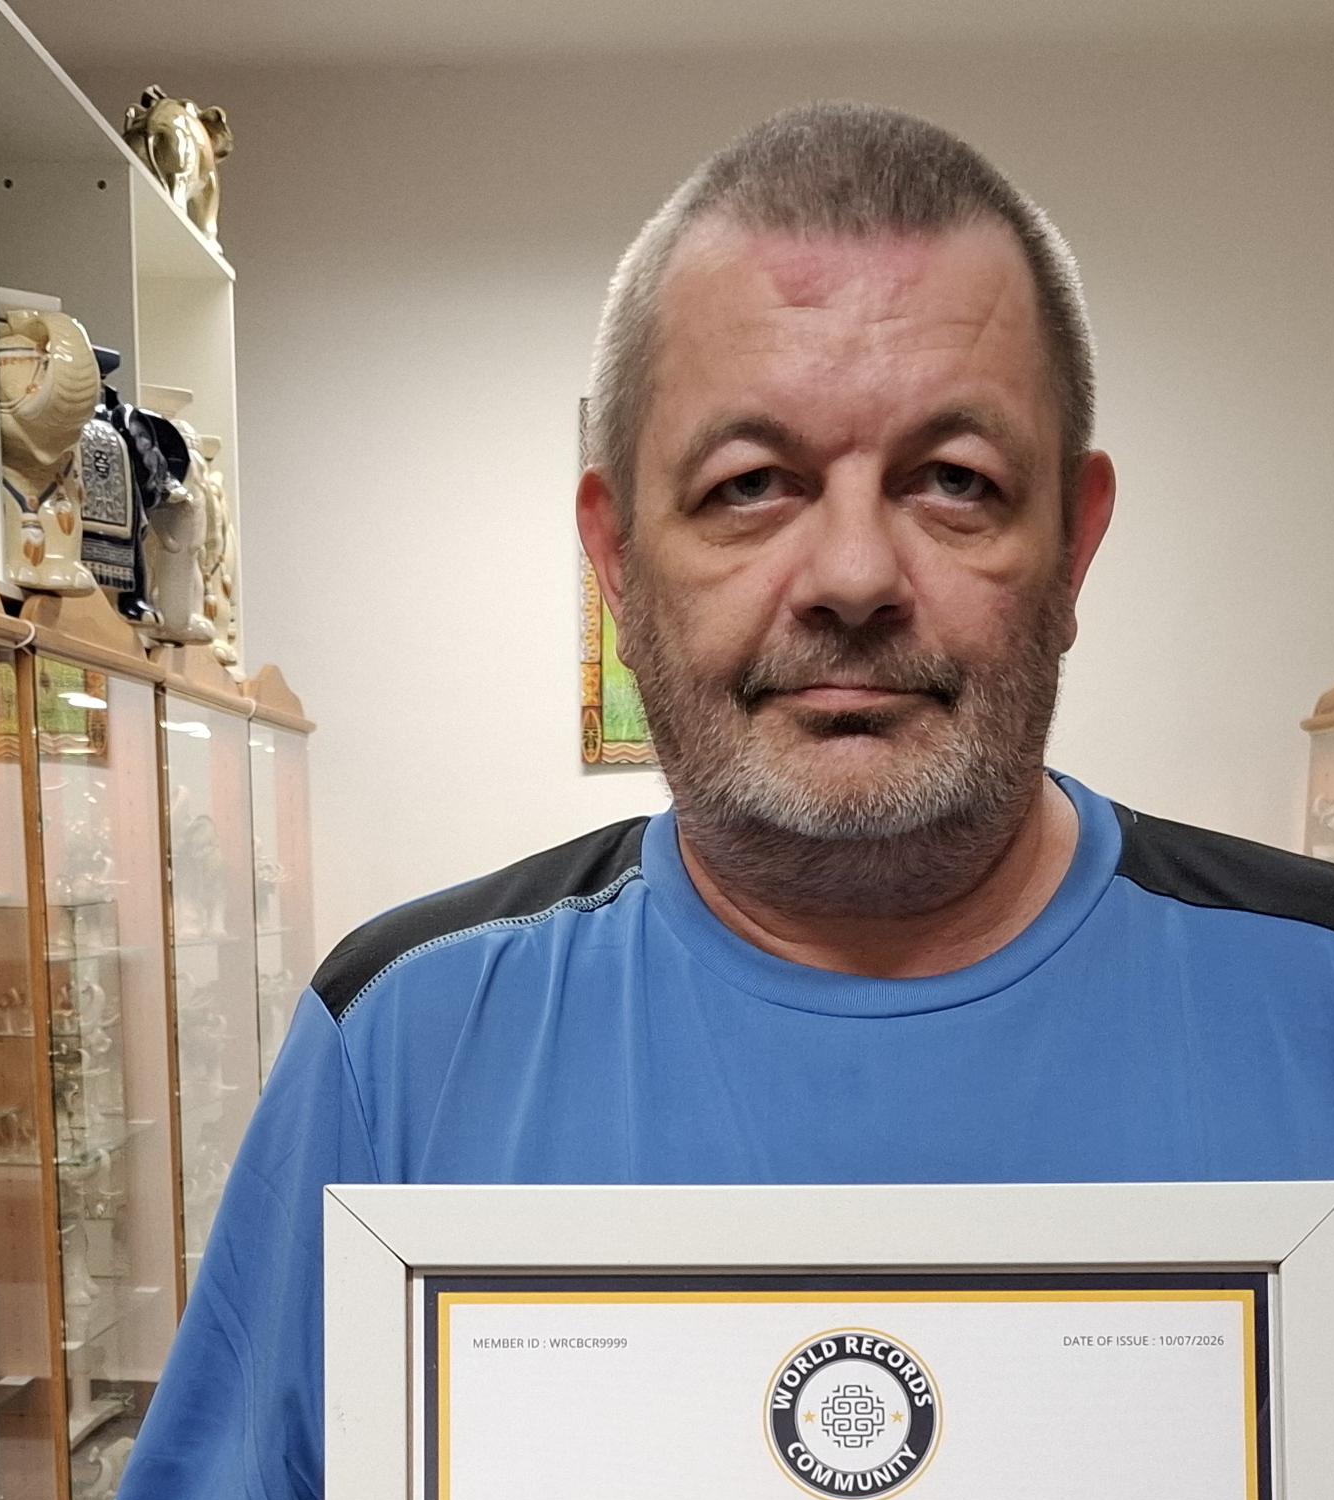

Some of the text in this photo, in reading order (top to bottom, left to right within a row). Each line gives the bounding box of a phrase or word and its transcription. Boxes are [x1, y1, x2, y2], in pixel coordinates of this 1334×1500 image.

[472, 1337, 525, 1349] MEMBER
[527, 1337, 540, 1349] ID
[548, 1337, 628, 1349] WRCBCR9999
[1063, 1335, 1094, 1347] DATE
[1096, 1335, 1113, 1347] OF
[1116, 1335, 1150, 1347] ISSUE
[1159, 1335, 1225, 1346] 10/07/2026
[773, 1337, 931, 1409] WORLD RECORDS
[787, 1441, 917, 1491] COMMUNITY
